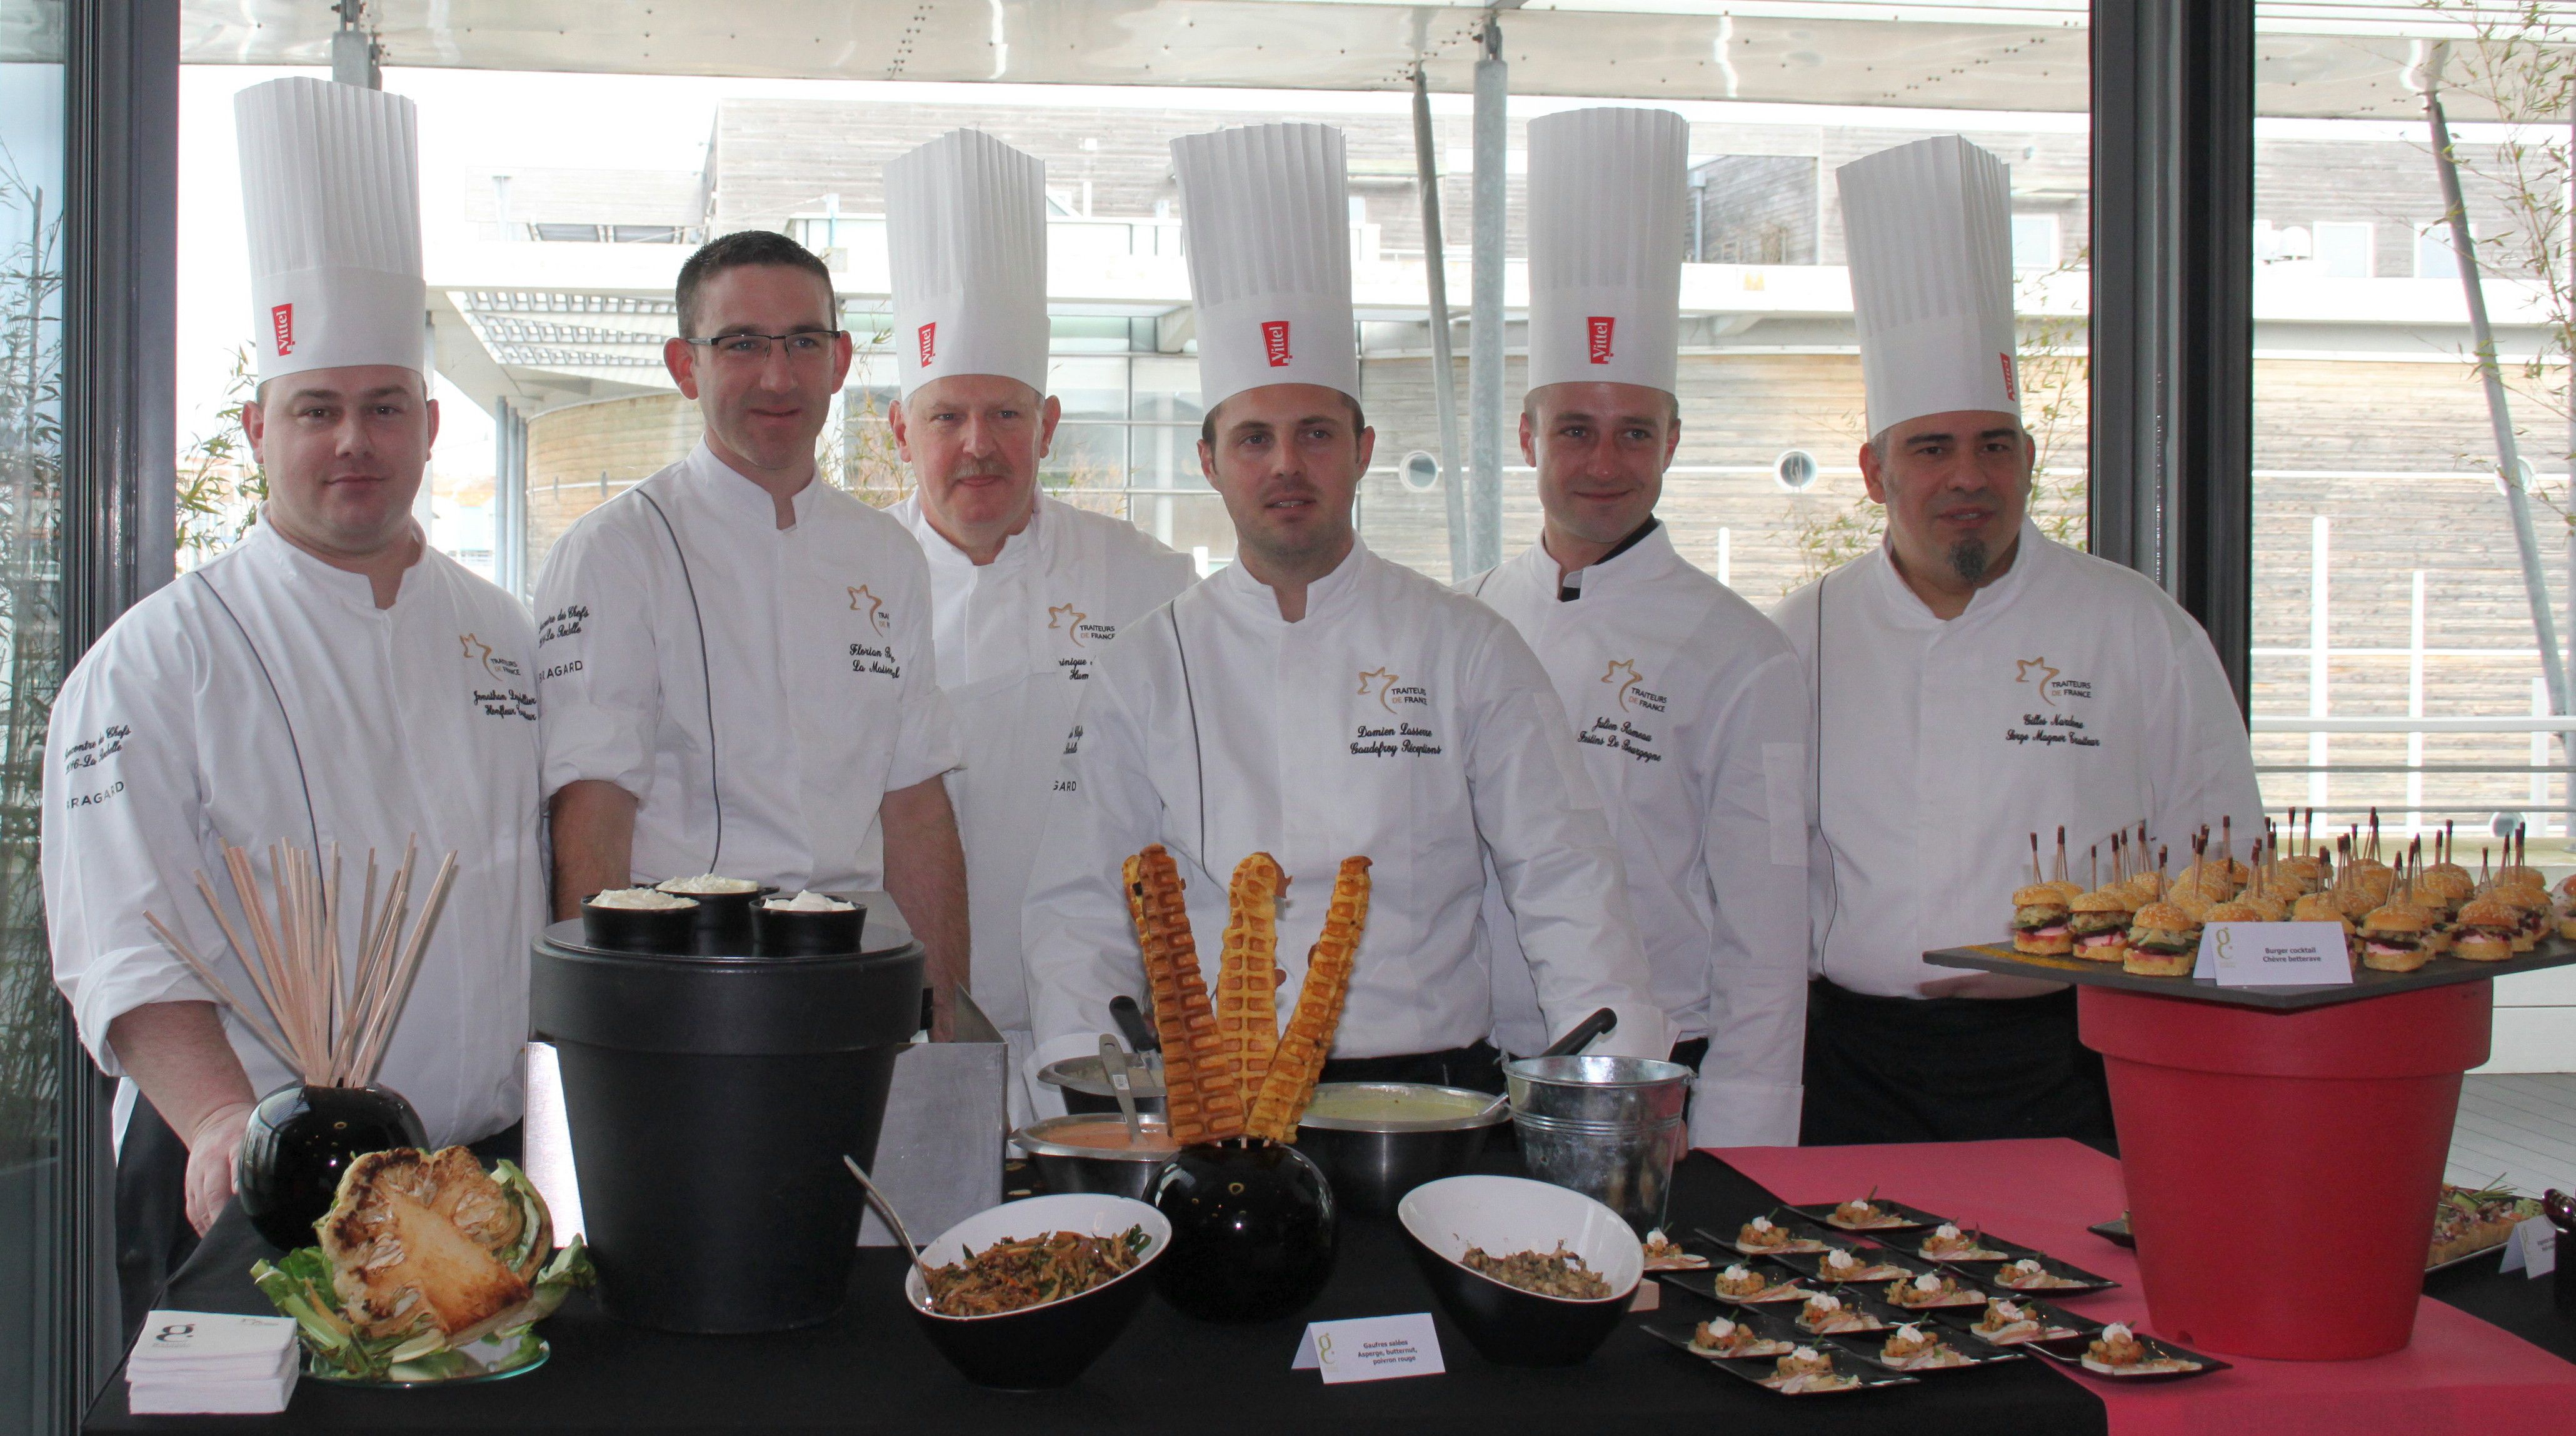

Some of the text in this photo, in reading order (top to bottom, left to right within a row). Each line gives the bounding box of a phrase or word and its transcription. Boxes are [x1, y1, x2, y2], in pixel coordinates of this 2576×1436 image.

[276, 310, 288, 349] Vittel
[922, 328, 931, 362] Vittel
[1269, 326, 1285, 361] Vittel
[1593, 322, 1608, 358] Vittel
[850, 644, 882, 656] Florian
[853, 660, 865, 672] La
[2051, 680, 2091, 688] TRAITEURS
[1631, 687, 1667, 703] TRAITEURS
[2063, 689, 2091, 698] FRANCE
[1640, 700, 1665, 713] FRANCE
[1591, 716, 1618, 732] Julien
[1358, 726, 1395, 738] Damien
[1373, 1355, 1416, 1365] poivron rouge
